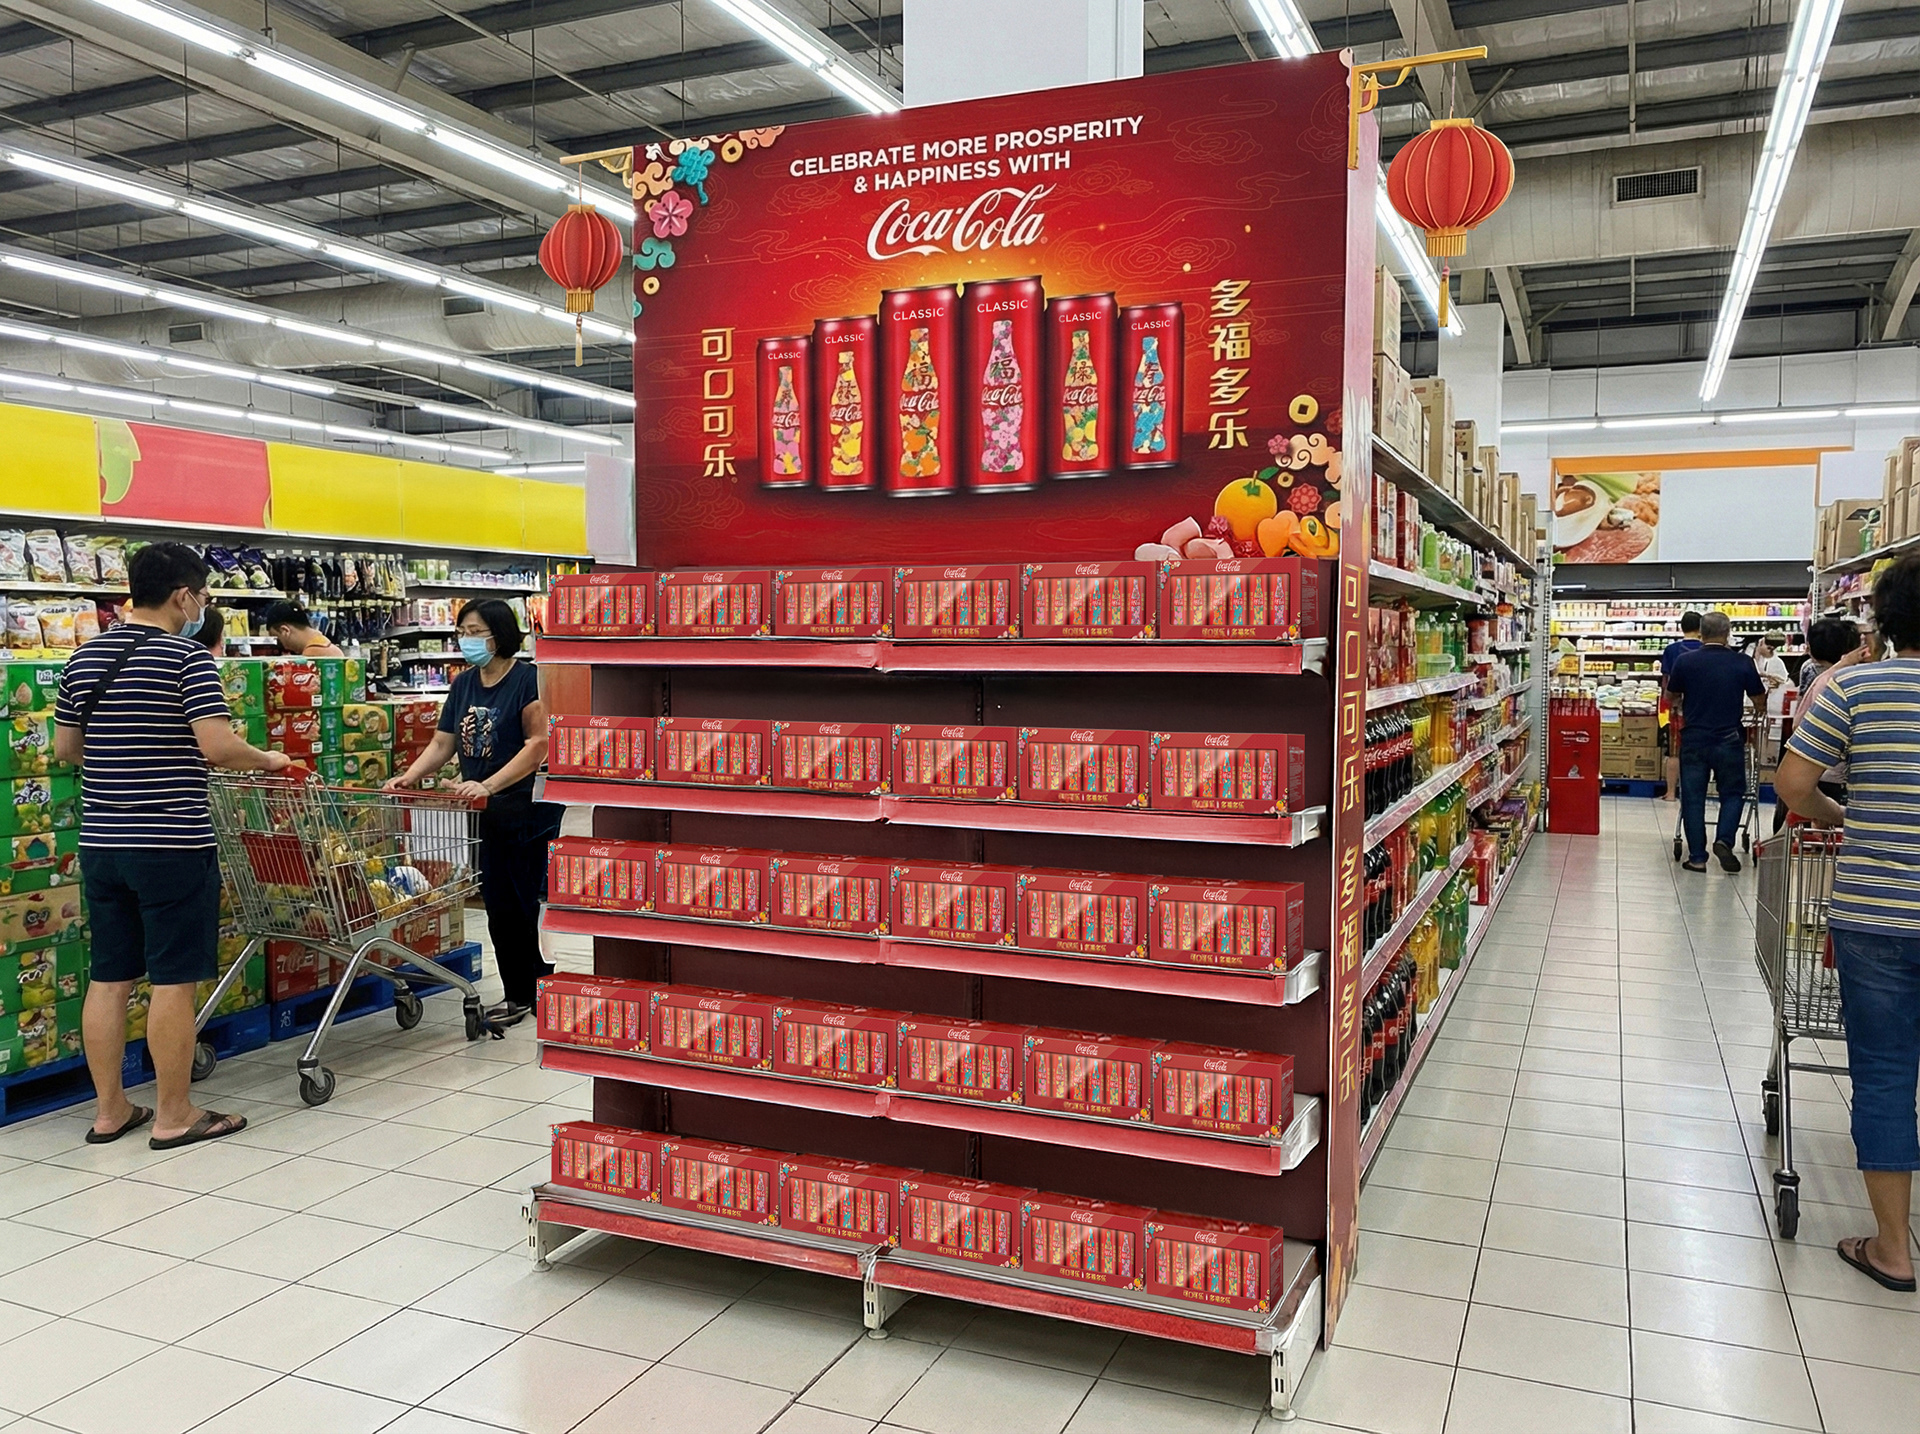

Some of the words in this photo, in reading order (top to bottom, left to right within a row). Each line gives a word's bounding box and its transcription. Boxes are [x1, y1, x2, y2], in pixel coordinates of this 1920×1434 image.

[789, 145, 916, 177] CELEBRATE
[922, 136, 988, 161] MORE
[994, 115, 1144, 152] PROSPERITY
[853, 175, 869, 194] &
[874, 160, 1001, 192] HAPPINESS
[1008, 151, 1071, 175] WITH
[867, 183, 1057, 260] Coca-Cola
[892, 307, 945, 321] CLASSIC
[977, 299, 1029, 313] CLASSIC
[1058, 311, 1102, 323] CLASSIC
[1131, 319, 1171, 331] CLASSIC
[767, 351, 801, 360] CLASSIC
[824, 333, 865, 344] CLASSIC
[1208, 279, 1251, 450] 多福多乐
[701, 327, 737, 478] 可口可乐
[1341, 562, 1363, 814] 可口可乐
[1339, 843, 1360, 1106] 多福多乐
